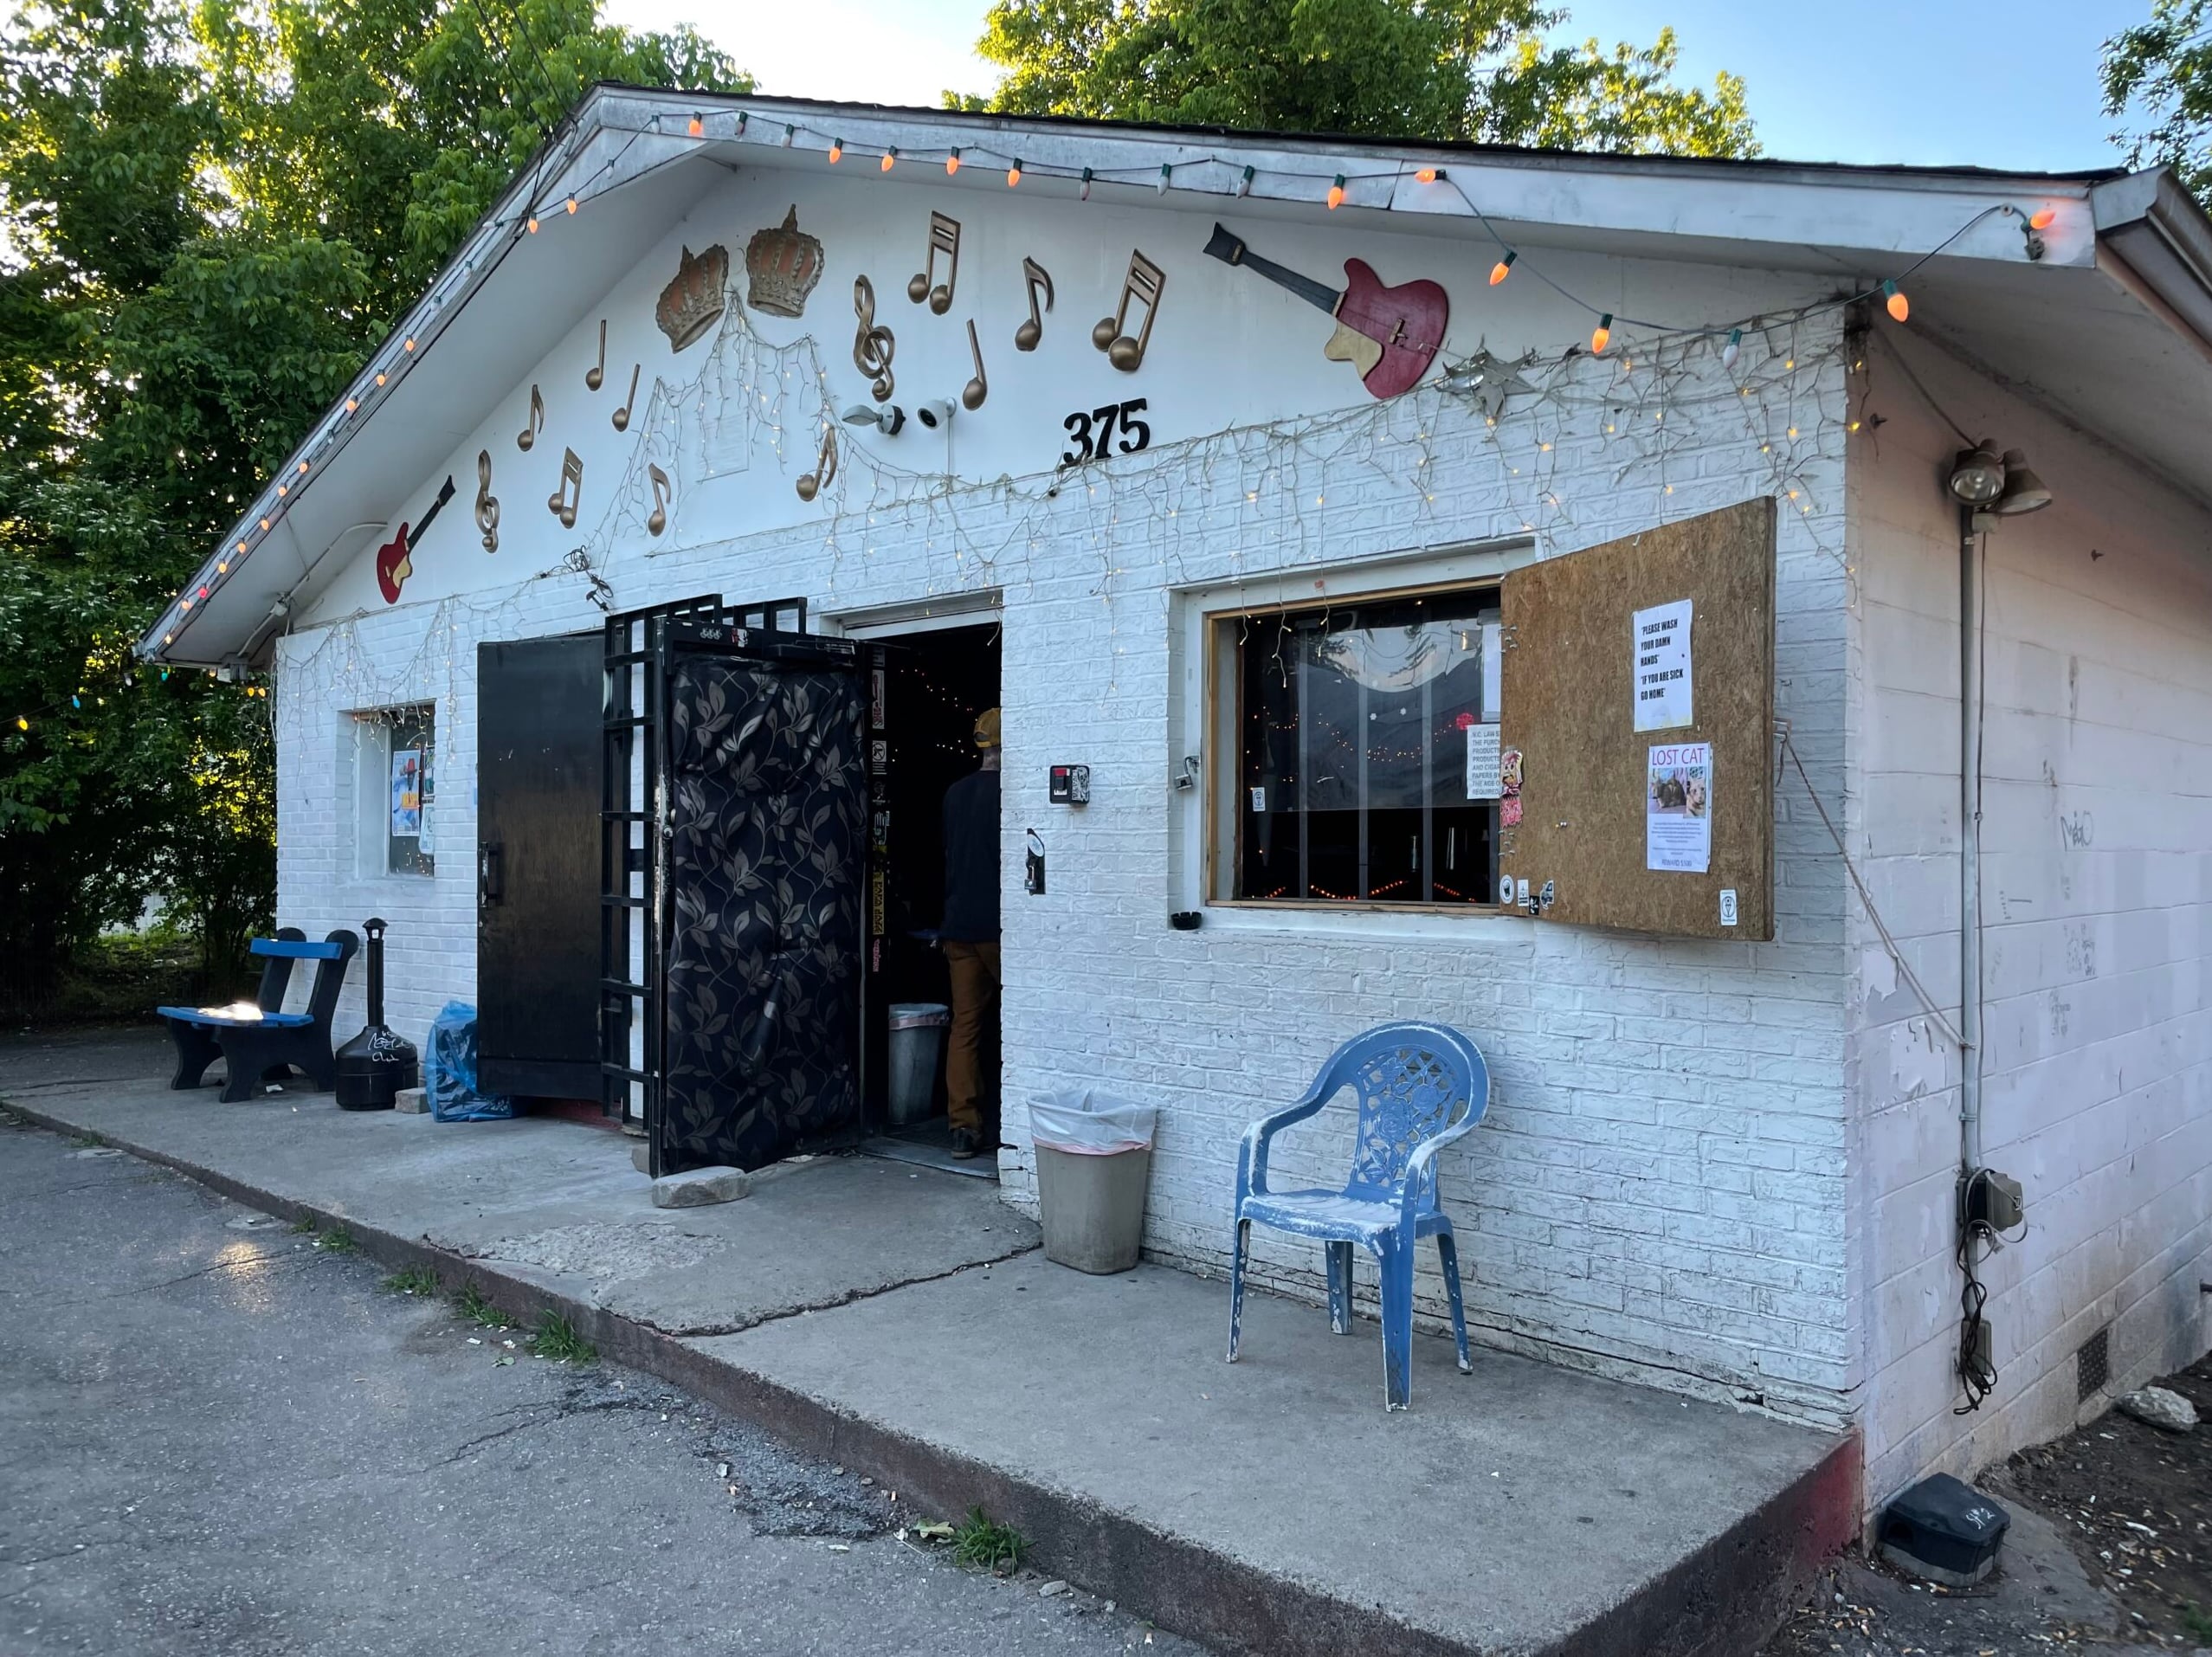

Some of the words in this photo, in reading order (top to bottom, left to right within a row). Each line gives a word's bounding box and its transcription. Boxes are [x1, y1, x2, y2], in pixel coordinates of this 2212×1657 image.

[1063, 397, 1151, 463] 375
[1661, 618, 1678, 631] WASH
[1641, 639, 1654, 651] YOUR
[1655, 636, 1671, 648] DAMN
[1648, 673, 1659, 684] YOU
[1659, 671, 1669, 681] ARE
[1669, 668, 1684, 680] SICK
[1641, 691, 1648, 700] GO
[1652, 750, 1680, 765] LOST
[1681, 748, 1705, 764] CAT
